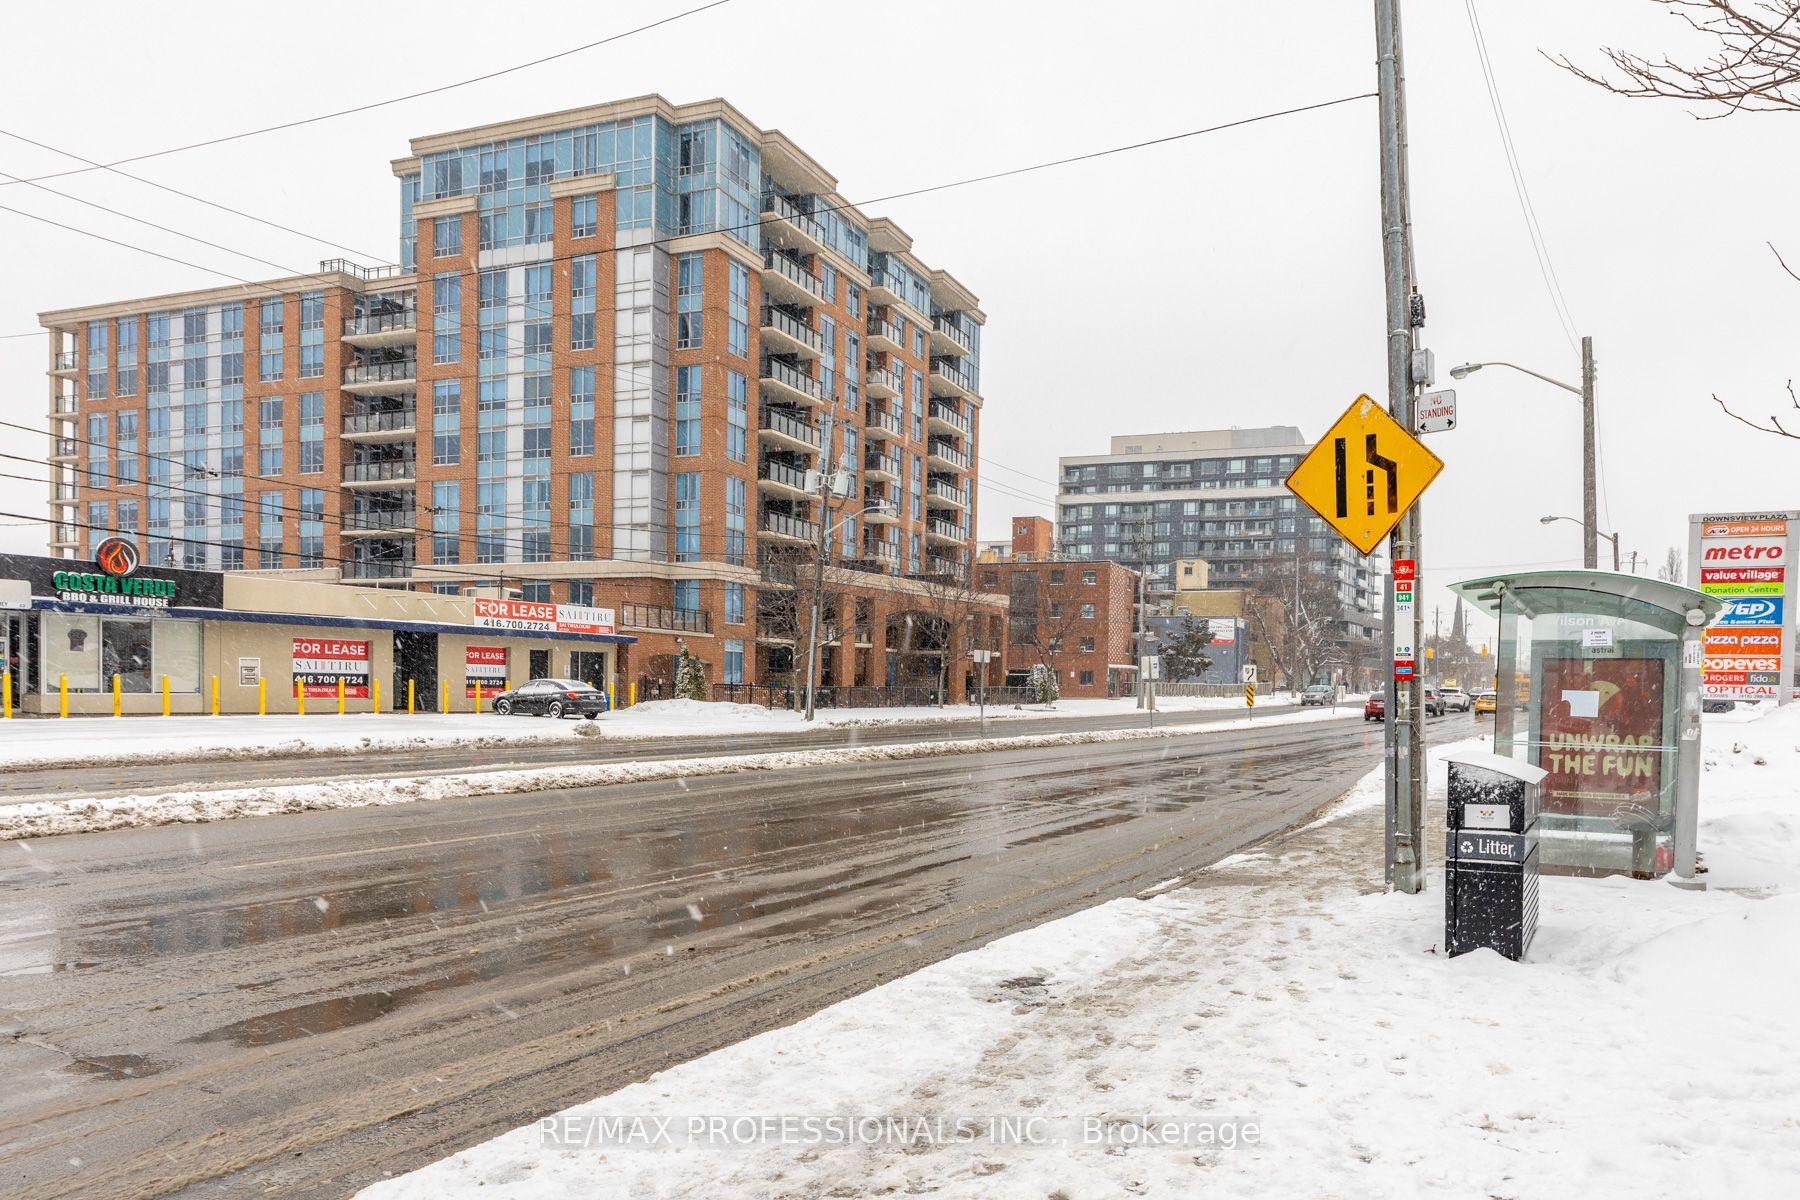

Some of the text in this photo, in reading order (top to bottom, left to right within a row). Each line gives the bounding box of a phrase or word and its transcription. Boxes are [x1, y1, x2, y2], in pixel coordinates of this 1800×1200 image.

[1420, 405, 1454, 420] STANDING
[1704, 545, 1783, 560] metro
[1705, 569, 1779, 580] value village
[54, 571, 175, 597] COSTA VERDE
[1400, 583, 1408, 591] 41
[1705, 586, 1745, 594] Donation
[62, 592, 169, 607] BBQ & GRILL HOUSE
[479, 601, 554, 619] FOR LEASE
[559, 609, 577, 620] SAI
[483, 618, 550, 631] 416.700.2724
[1741, 635, 1779, 648] pizza
[293, 643, 366, 656] FOR LEASE
[481, 652, 505, 660] LEASE
[295, 660, 363, 671] SAI TIRU
[1709, 674, 1745, 682] ROGERS
[1750, 674, 1768, 683] fido
[1707, 686, 1777, 695] OPTICAL
[1549, 733, 1654, 753] UNWRAP
[1549, 754, 1654, 777] THE FUN
[1479, 838, 1514, 856] Litter
